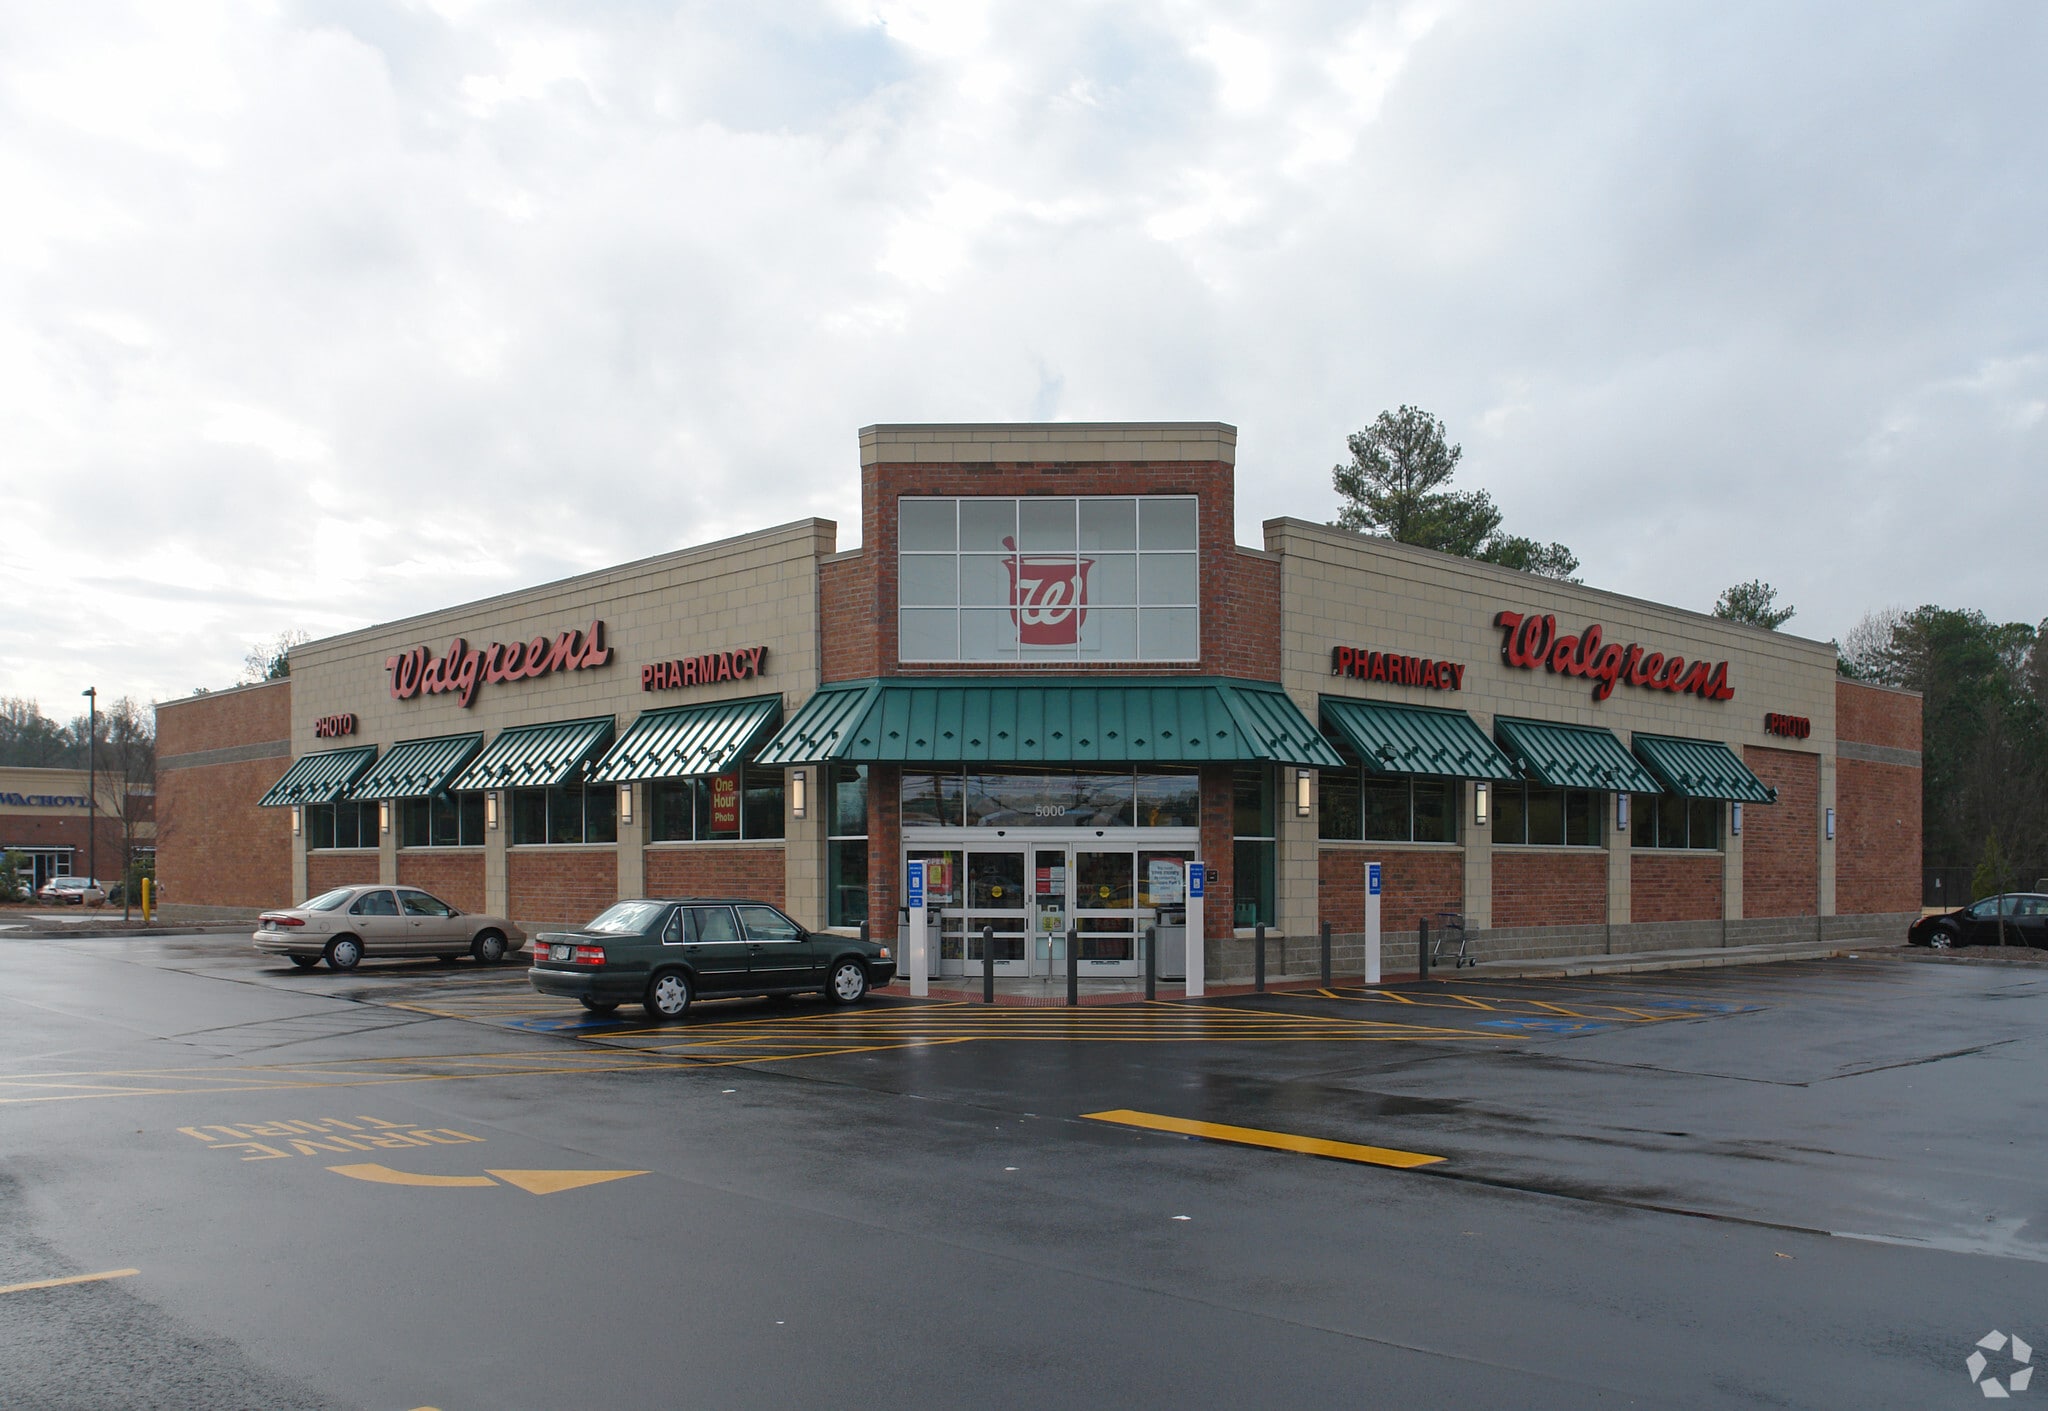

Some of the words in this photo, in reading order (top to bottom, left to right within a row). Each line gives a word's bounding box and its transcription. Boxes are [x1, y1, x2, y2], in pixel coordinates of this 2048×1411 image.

[385, 620, 612, 708] Walgreens
[1335, 646, 1465, 690] PHARMACY
[1497, 611, 1735, 700] Walgreens
[641, 646, 767, 691] PHARMACY
[315, 713, 355, 737] PHOTO
[1769, 713, 1810, 738] PHOTO
[715, 777, 733, 792] One
[713, 793, 735, 808] Hour
[1035, 805, 1065, 816] 5000
[714, 812, 735, 822] Photo
[176, 1115, 418, 1141] THRU
[207, 1128, 487, 1161] DRIVE
